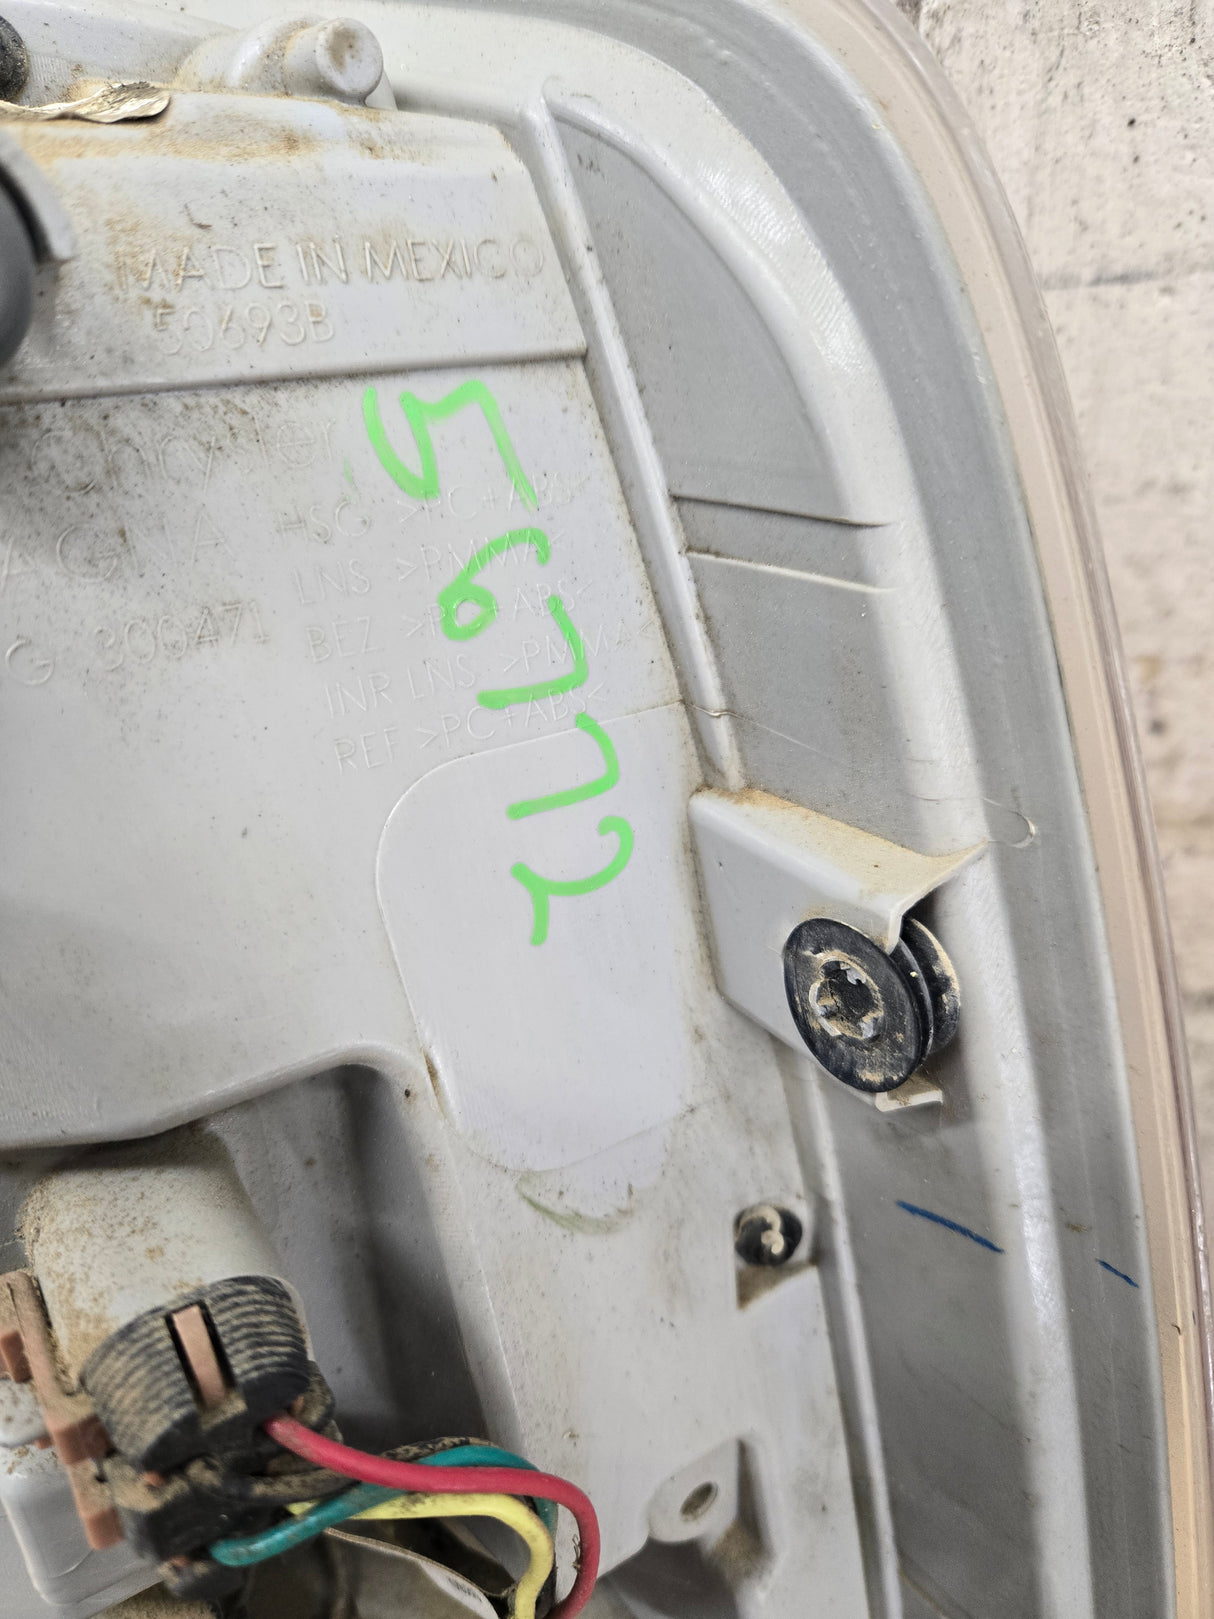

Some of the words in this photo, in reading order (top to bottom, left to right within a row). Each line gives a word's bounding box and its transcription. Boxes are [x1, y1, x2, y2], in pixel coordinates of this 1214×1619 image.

[117, 242, 285, 294] MADE
[297, 237, 350, 287] IN
[363, 237, 546, 285] MEXICO
[152, 300, 334, 355] 50693B
[274, 498, 374, 546] HSG
[292, 558, 371, 606] LNS
[92, 600, 272, 672] 300471
[304, 615, 380, 664] BEZ
[323, 670, 394, 719] INR
[406, 654, 476, 700] LNS
[334, 725, 400, 773] REF
